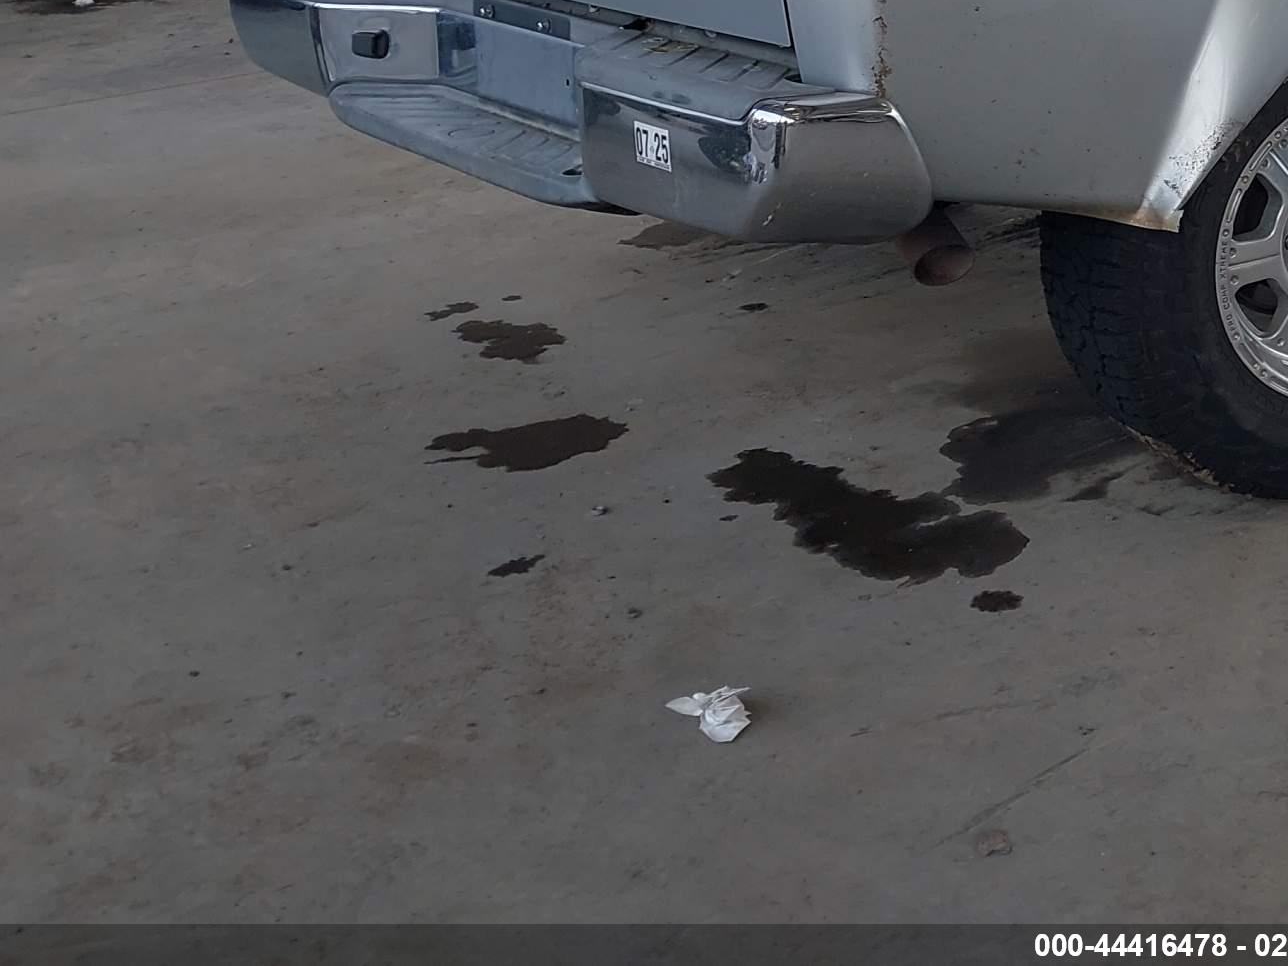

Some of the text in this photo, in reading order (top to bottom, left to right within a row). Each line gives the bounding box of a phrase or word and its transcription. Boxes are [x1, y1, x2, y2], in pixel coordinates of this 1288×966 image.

[636, 127, 649, 158] 07
[654, 133, 669, 164] 25
[1219, 241, 1236, 331] PRO COMP XTREME
